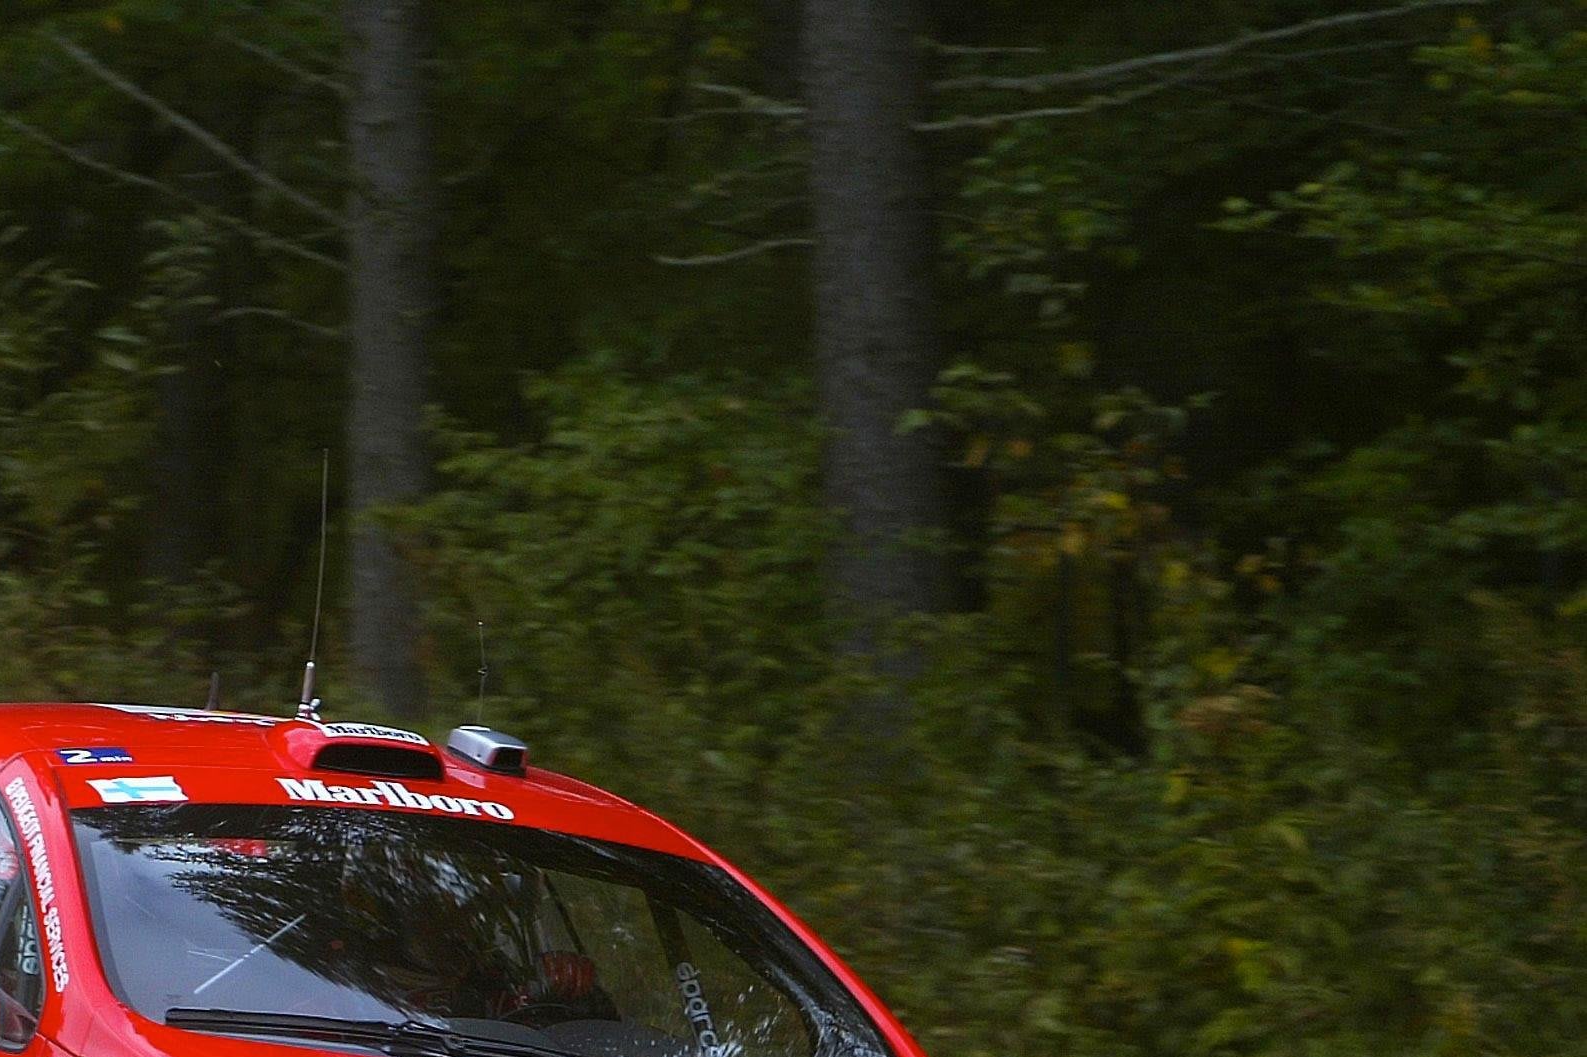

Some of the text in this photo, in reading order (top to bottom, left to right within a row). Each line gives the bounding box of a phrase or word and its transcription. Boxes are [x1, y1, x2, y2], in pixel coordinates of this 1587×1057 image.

[326, 724, 422, 743] Marlboro
[275, 777, 514, 820] Marlboro
[43, 906, 69, 993] SERVICES
